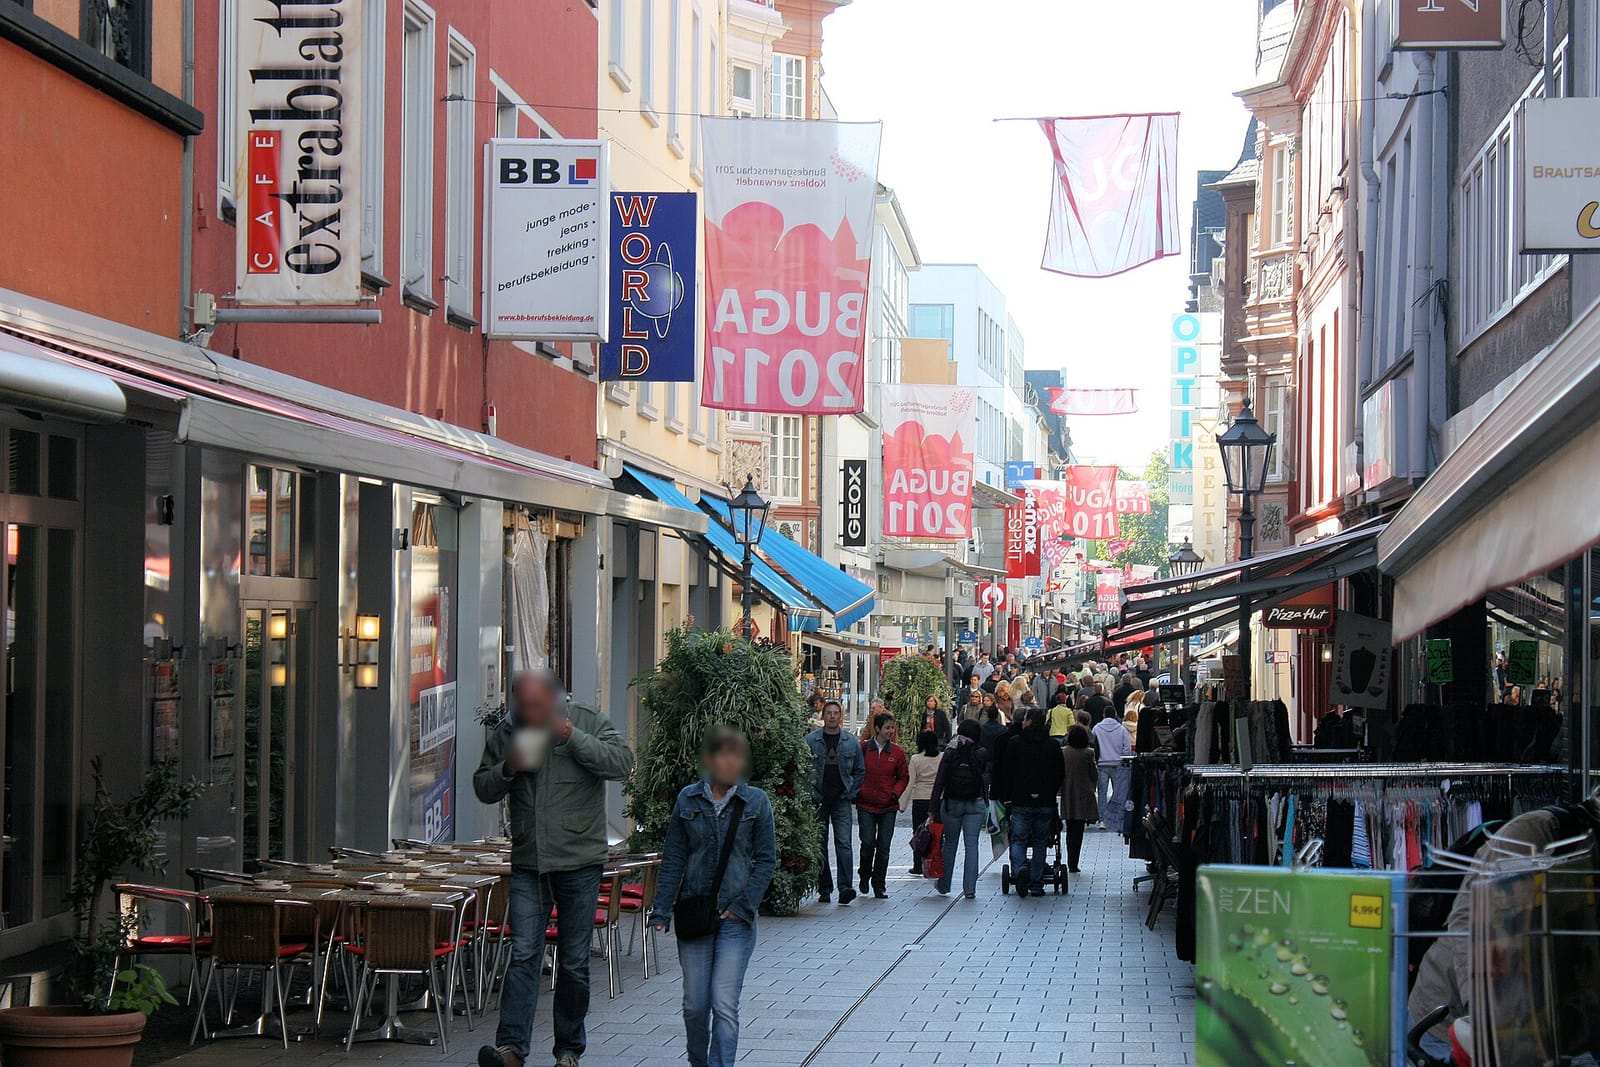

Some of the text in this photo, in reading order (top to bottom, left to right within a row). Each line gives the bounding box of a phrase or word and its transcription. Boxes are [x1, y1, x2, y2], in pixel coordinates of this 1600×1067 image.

[526, 203, 590, 232] junge mode
[560, 221, 589, 238] jeans
[547, 238, 589, 258] trekking
[498, 256, 589, 292] berufsbekleidung
[614, 195, 657, 377] WORLD
[498, 314, 594, 322] www.bb-berufsbekleidung.de
[1173, 314, 1199, 469] OPTIK
[848, 466, 862, 539] GEOX
[1070, 485, 1113, 509] UGA
[1008, 510, 1022, 563] ESPRIT
[1073, 511, 1115, 538] 011
[1268, 608, 1328, 620] Pizza Hut
[1219, 888, 1233, 912] 2012
[1236, 888, 1290, 915] ZEN
